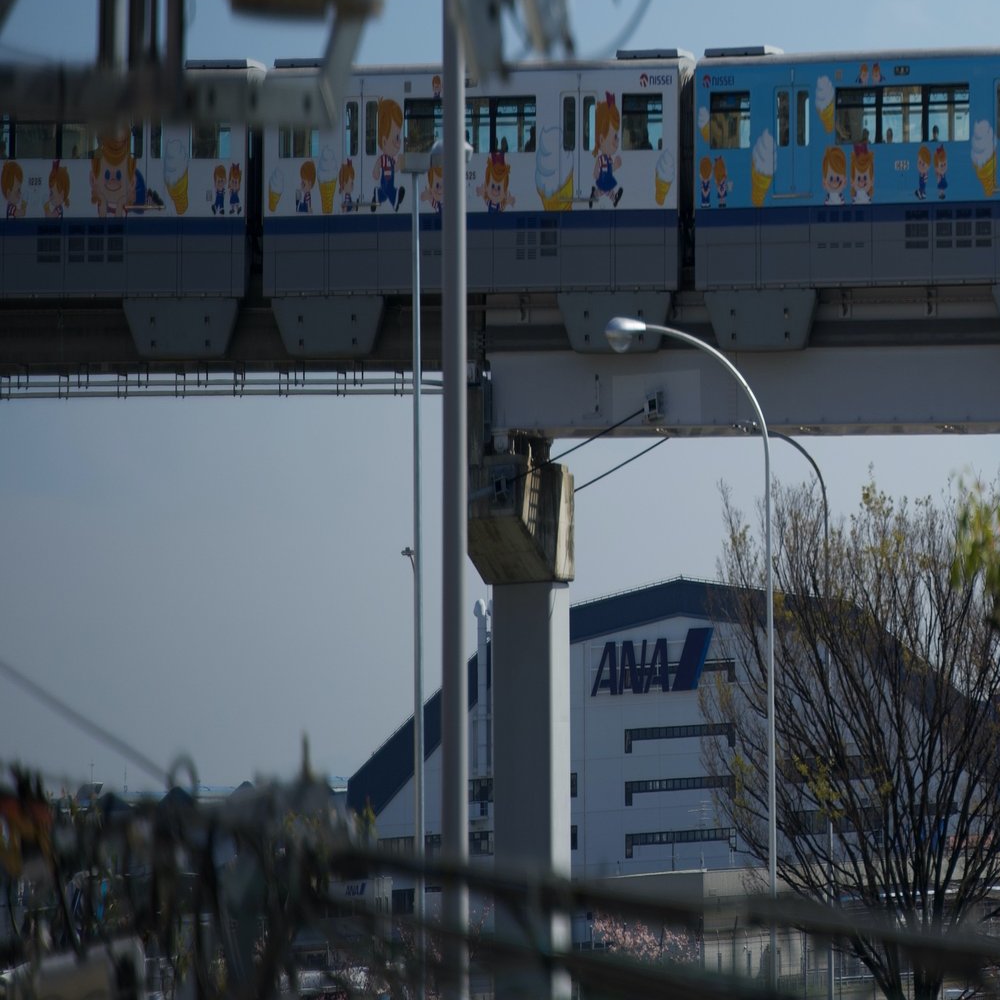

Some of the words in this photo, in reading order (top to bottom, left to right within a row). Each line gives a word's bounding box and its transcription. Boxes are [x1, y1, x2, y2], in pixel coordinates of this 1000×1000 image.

[649, 75, 673, 86] NISSEI
[711, 75, 735, 86] NISSEI
[590, 638, 670, 697] ANA
